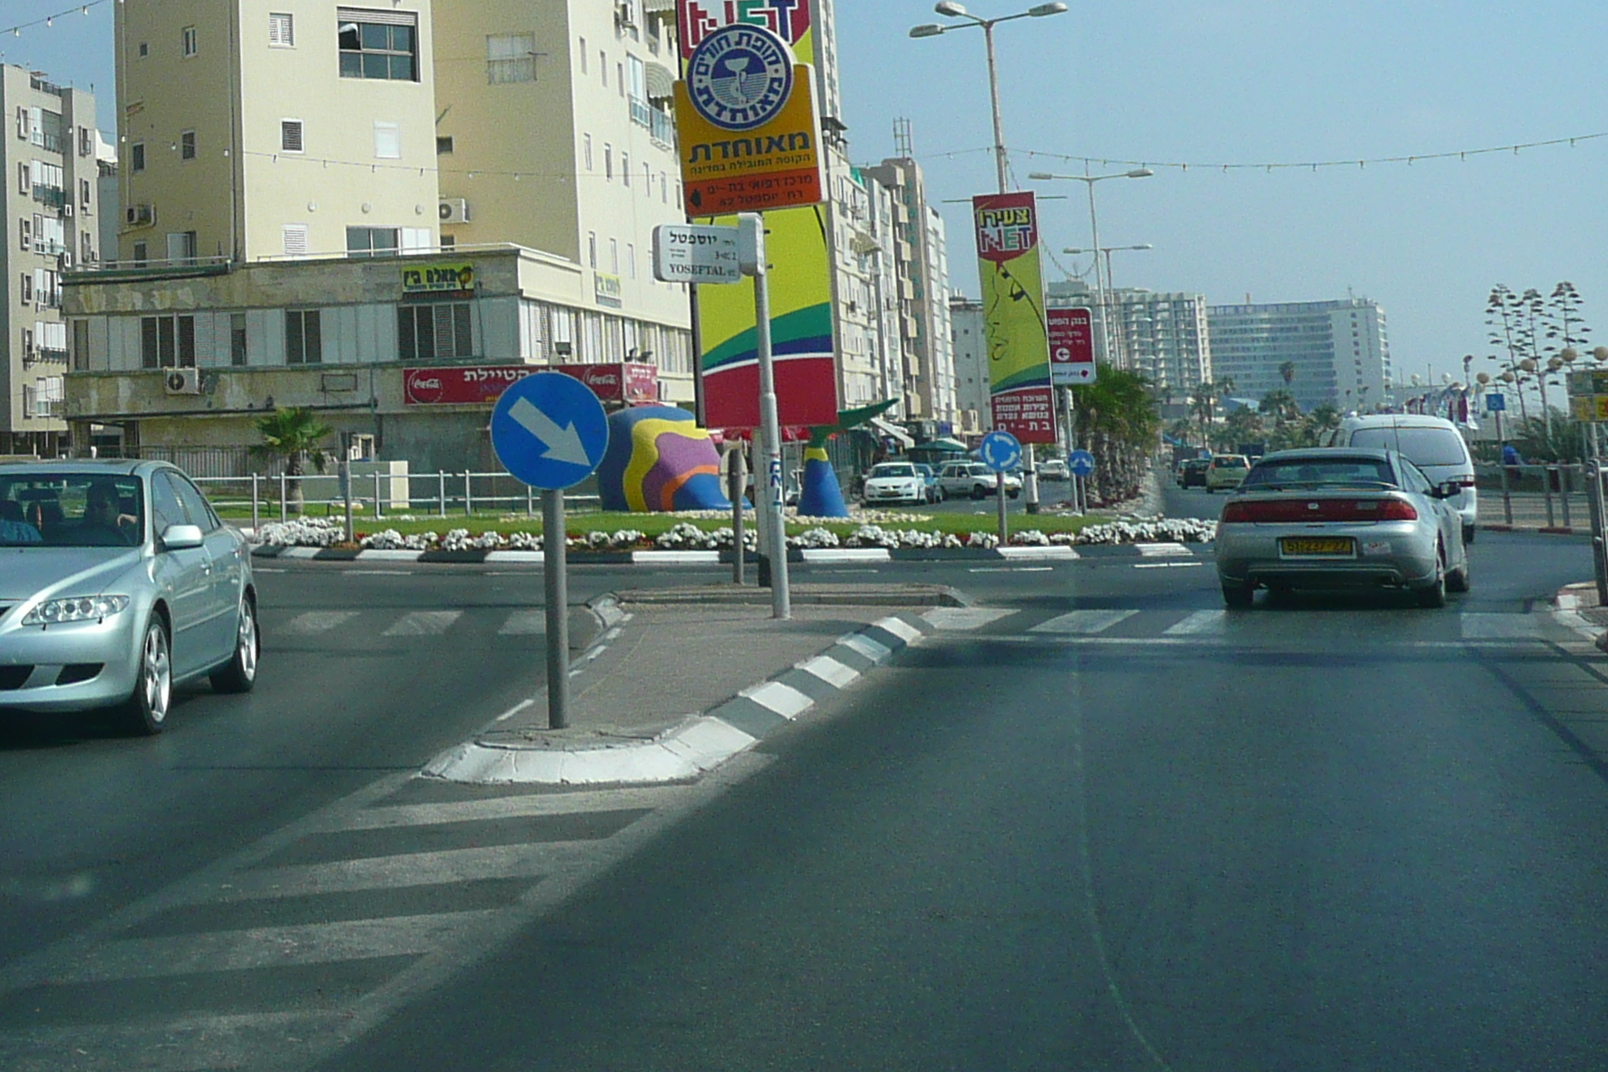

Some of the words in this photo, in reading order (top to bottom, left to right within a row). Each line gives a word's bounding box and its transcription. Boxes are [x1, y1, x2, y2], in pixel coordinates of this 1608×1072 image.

[695, 77, 784, 122] מאוחדת
[689, 131, 810, 163] מאוחדת
[669, 230, 718, 245] יוספטל
[980, 227, 1032, 252] NET
[669, 263, 726, 277] YOSEFTAL
